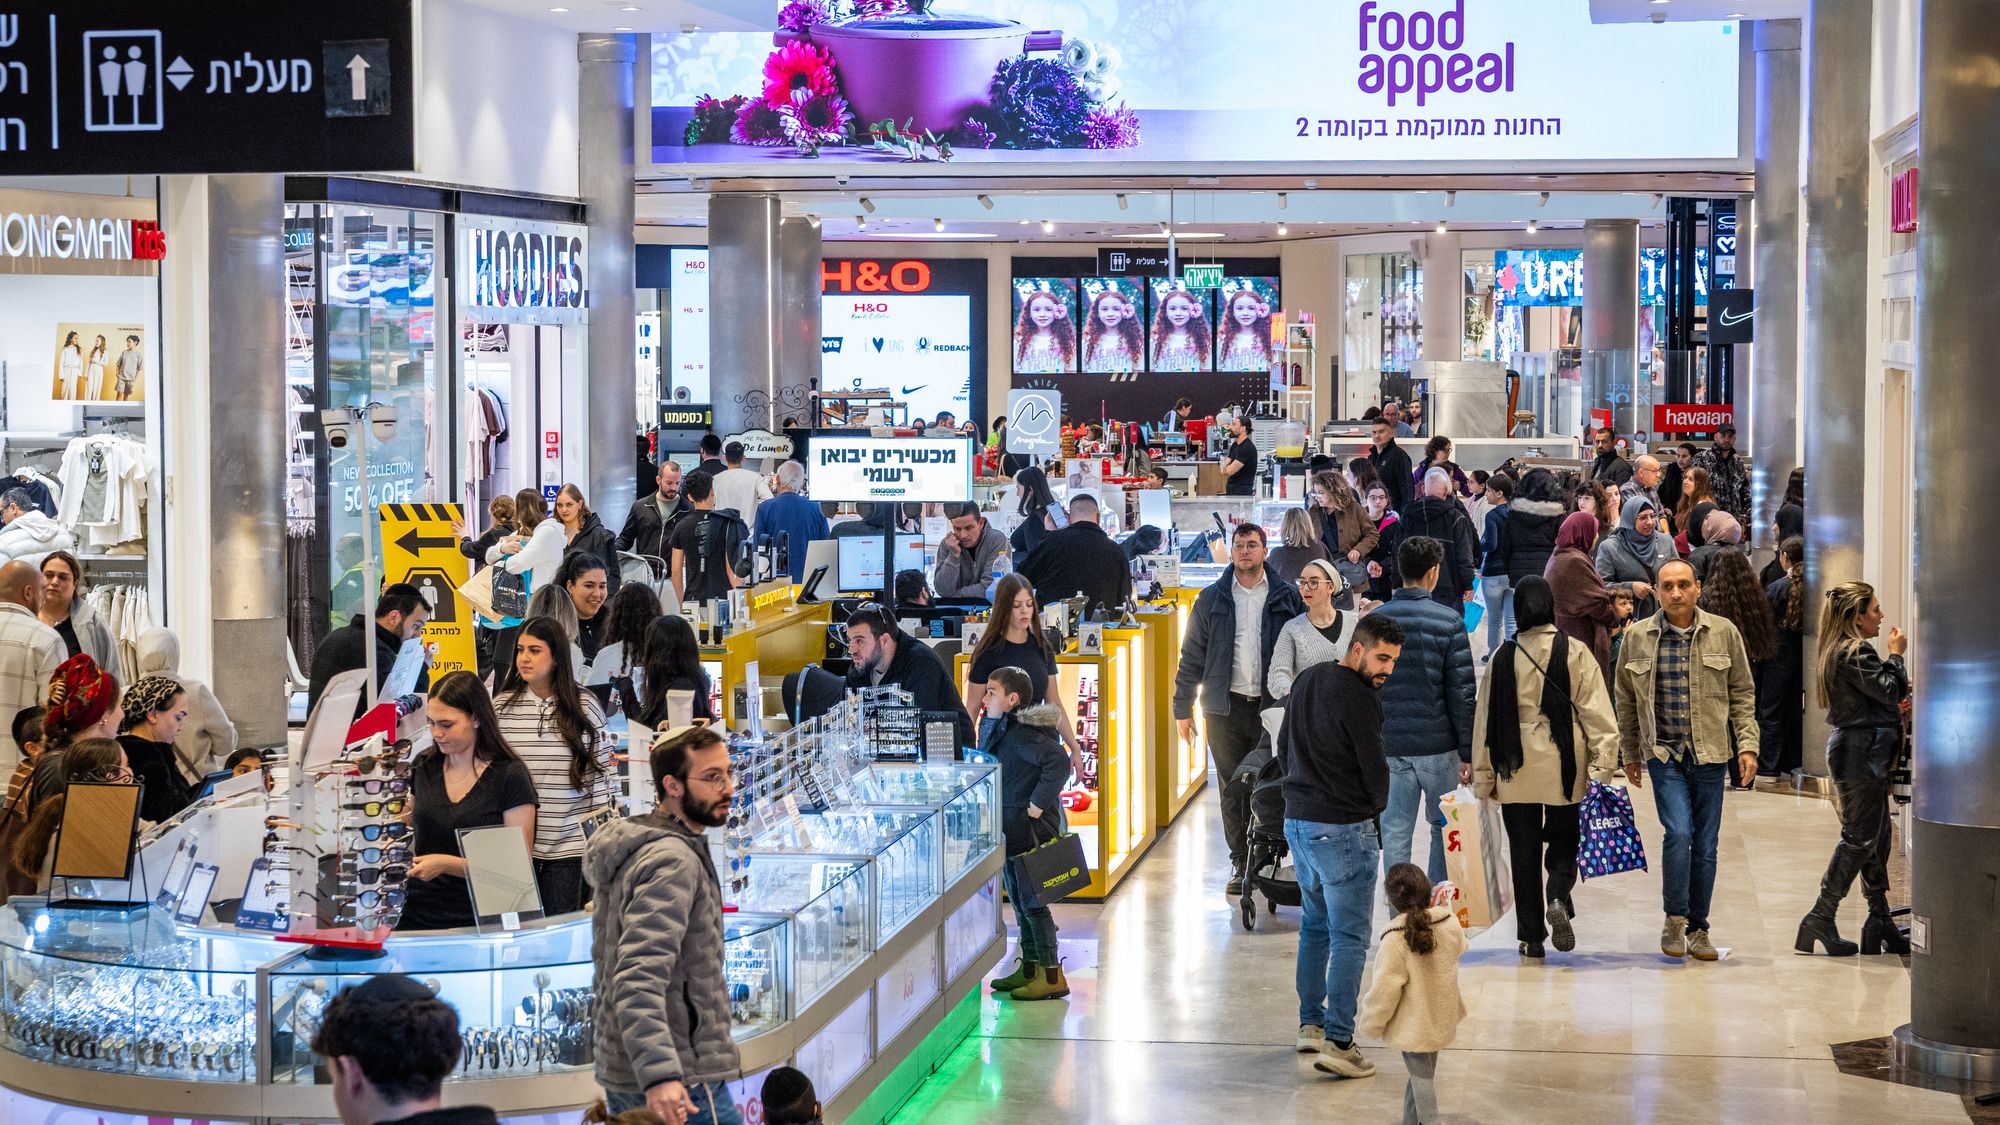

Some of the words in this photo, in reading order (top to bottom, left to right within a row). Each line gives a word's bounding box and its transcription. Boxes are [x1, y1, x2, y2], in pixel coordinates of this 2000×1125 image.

[1359, 0, 1464, 51] food
[205, 51, 313, 94] מעלית
[1357, 42, 1515, 107] appeal
[1296, 117, 1309, 137] 2
[1317, 118, 1388, 140] בקומה
[1396, 118, 1486, 140] ממוקמת
[1493, 118, 1561, 136] החנות
[0, 211, 133, 260] ONiGMAN
[132, 219, 167, 261] kids
[685, 261, 706, 269] H&O
[1136, 258, 1156, 266] מעלית
[821, 261, 931, 293] H&O
[1189, 268, 1218, 287] יציאה
[854, 303, 888, 313] H&O
[664, 412, 703, 423] כספומט
[1665, 408, 1737, 425] havaian
[821, 448, 867, 466] יבואן
[872, 449, 956, 463] מכשירים
[366, 461, 414, 478] COLLECTION
[863, 468, 914, 482] רשמי
[381, 478, 414, 504] OFF
[430, 626, 461, 635] למרחב
[443, 661, 463, 672] קניון
